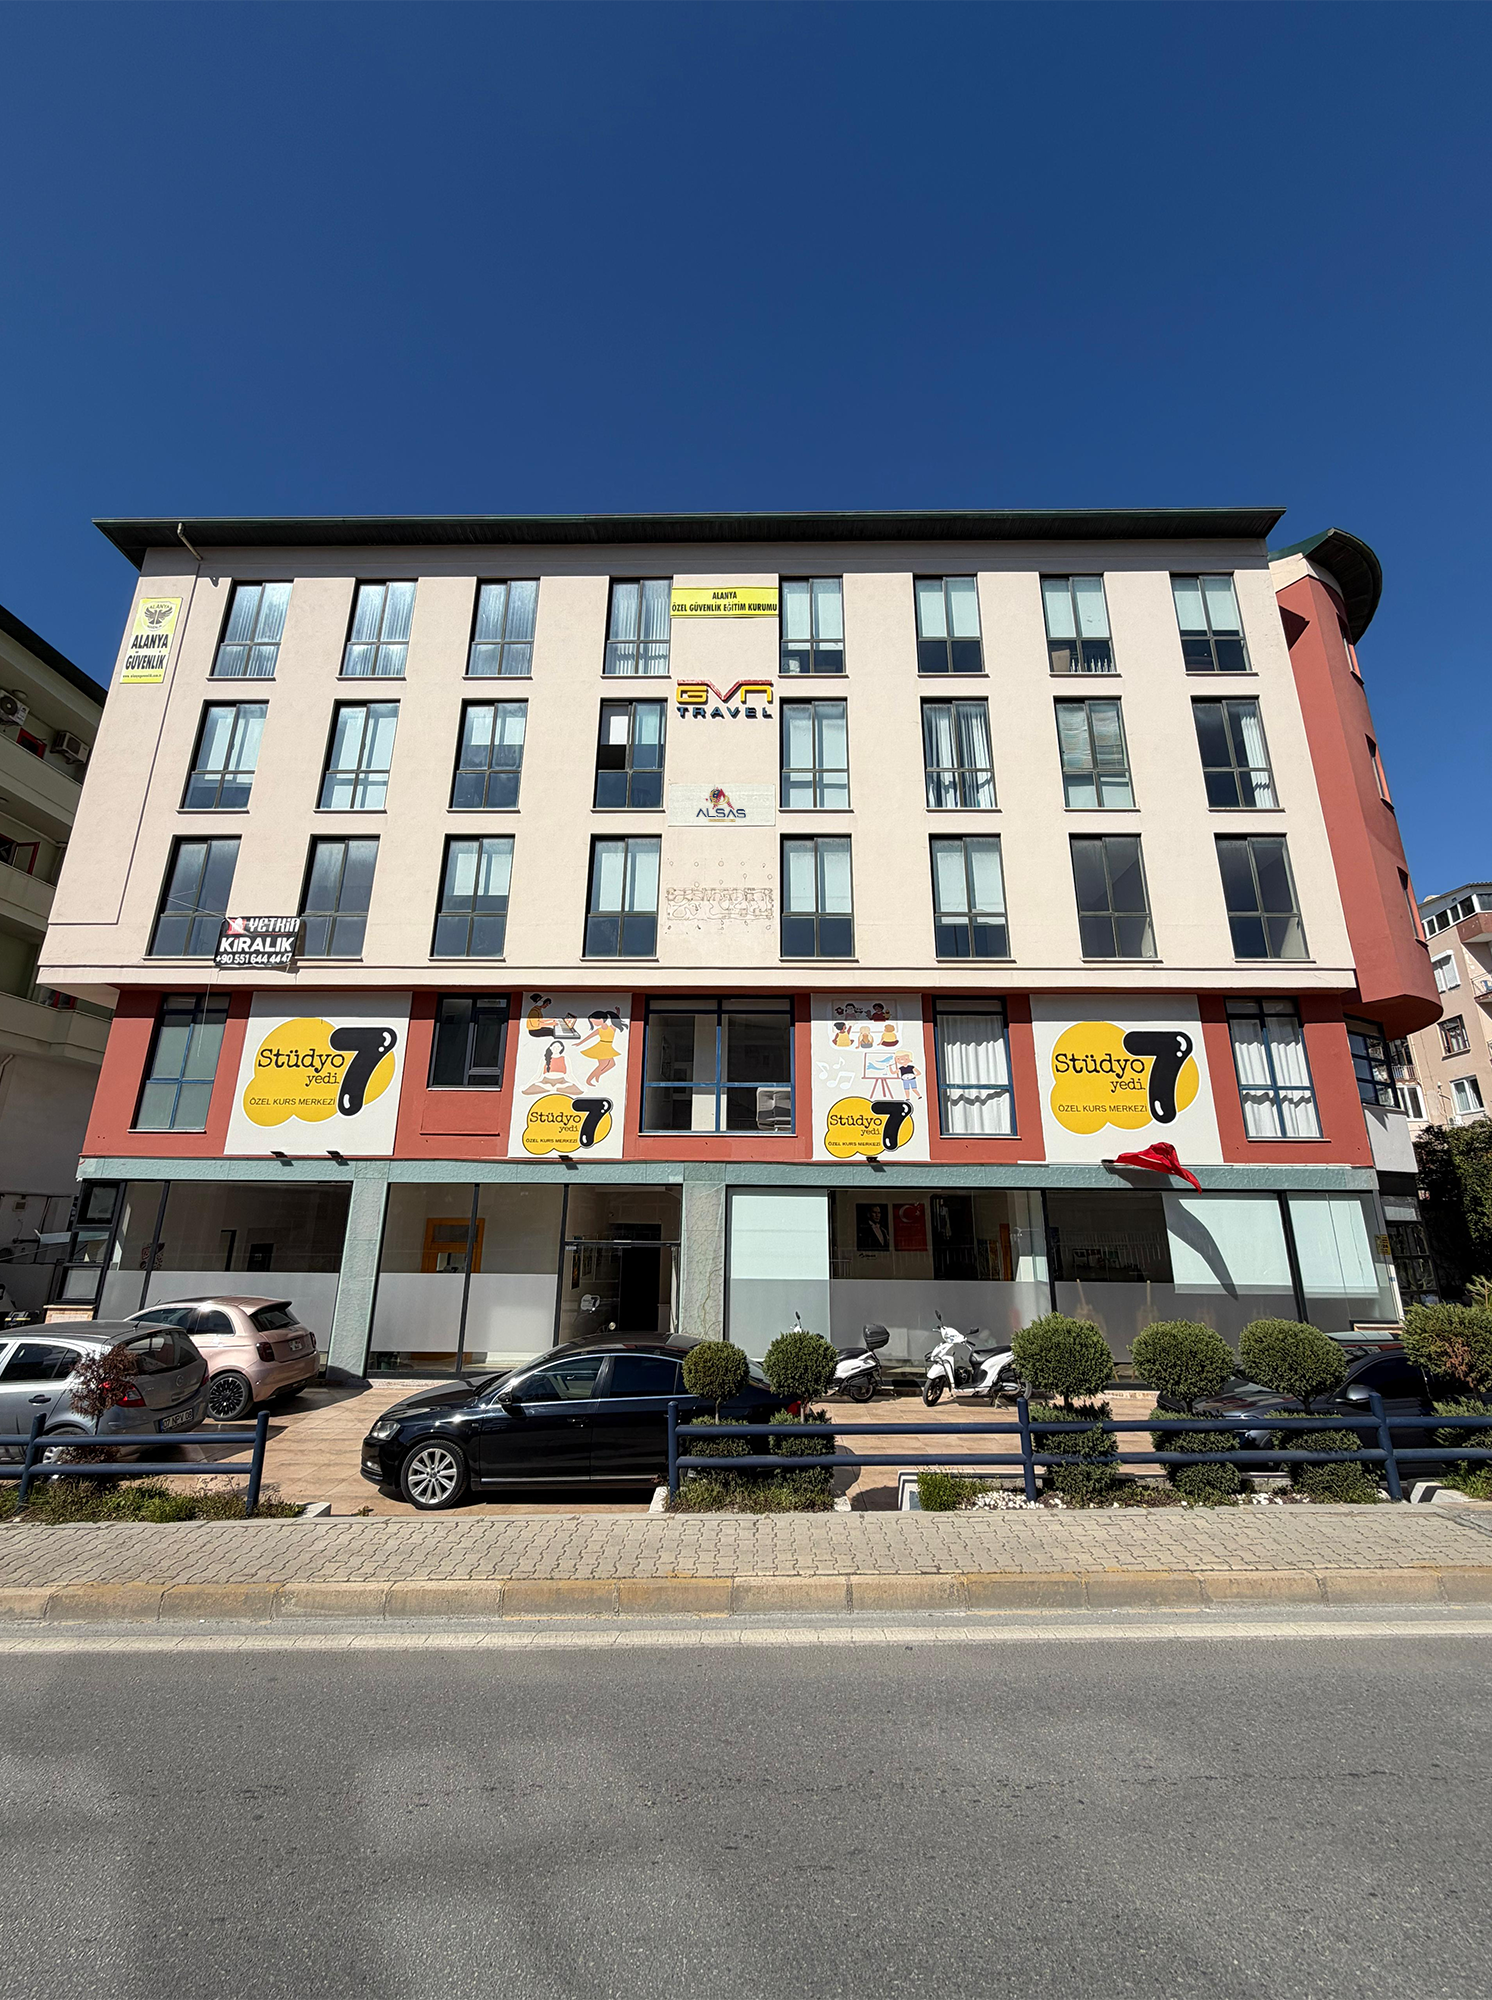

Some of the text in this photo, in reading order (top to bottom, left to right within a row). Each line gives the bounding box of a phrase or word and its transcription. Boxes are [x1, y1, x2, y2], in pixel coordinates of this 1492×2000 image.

[711, 591, 737, 600] ALANYA
[671, 601, 777, 612] ÖZEL GÜVENLİK EĞİTİM KURUMU
[131, 634, 169, 649] ALANYA
[125, 650, 166, 670] GÜVENLİK
[676, 706, 774, 720] TRAVEL
[696, 808, 747, 818] ALSAS
[215, 954, 233, 964] +90
[234, 954, 249, 964] 551
[250, 954, 268, 964] 644
[269, 954, 280, 963] 44
[257, 1048, 345, 1073] Stüdyo
[1055, 1053, 1145, 1079] Stüdyo
[305, 1072, 340, 1087] yedi
[330, 1027, 398, 1117] 7
[1123, 1031, 1193, 1124] 7
[1110, 1078, 1146, 1093] yedi
[249, 1097, 271, 1106] ÖZEL
[298, 1096, 336, 1105] MERKEZİ
[1058, 1103, 1081, 1112] ÖZEL
[1109, 1103, 1148, 1112] MERKEZİ
[529, 1111, 582, 1126] Stüdyo
[572, 1099, 611, 1147] 7
[829, 1114, 882, 1128] Stüdyo
[871, 1102, 911, 1150] 7
[558, 1125, 579, 1133] yedi
[860, 1128, 881, 1136] yedi
